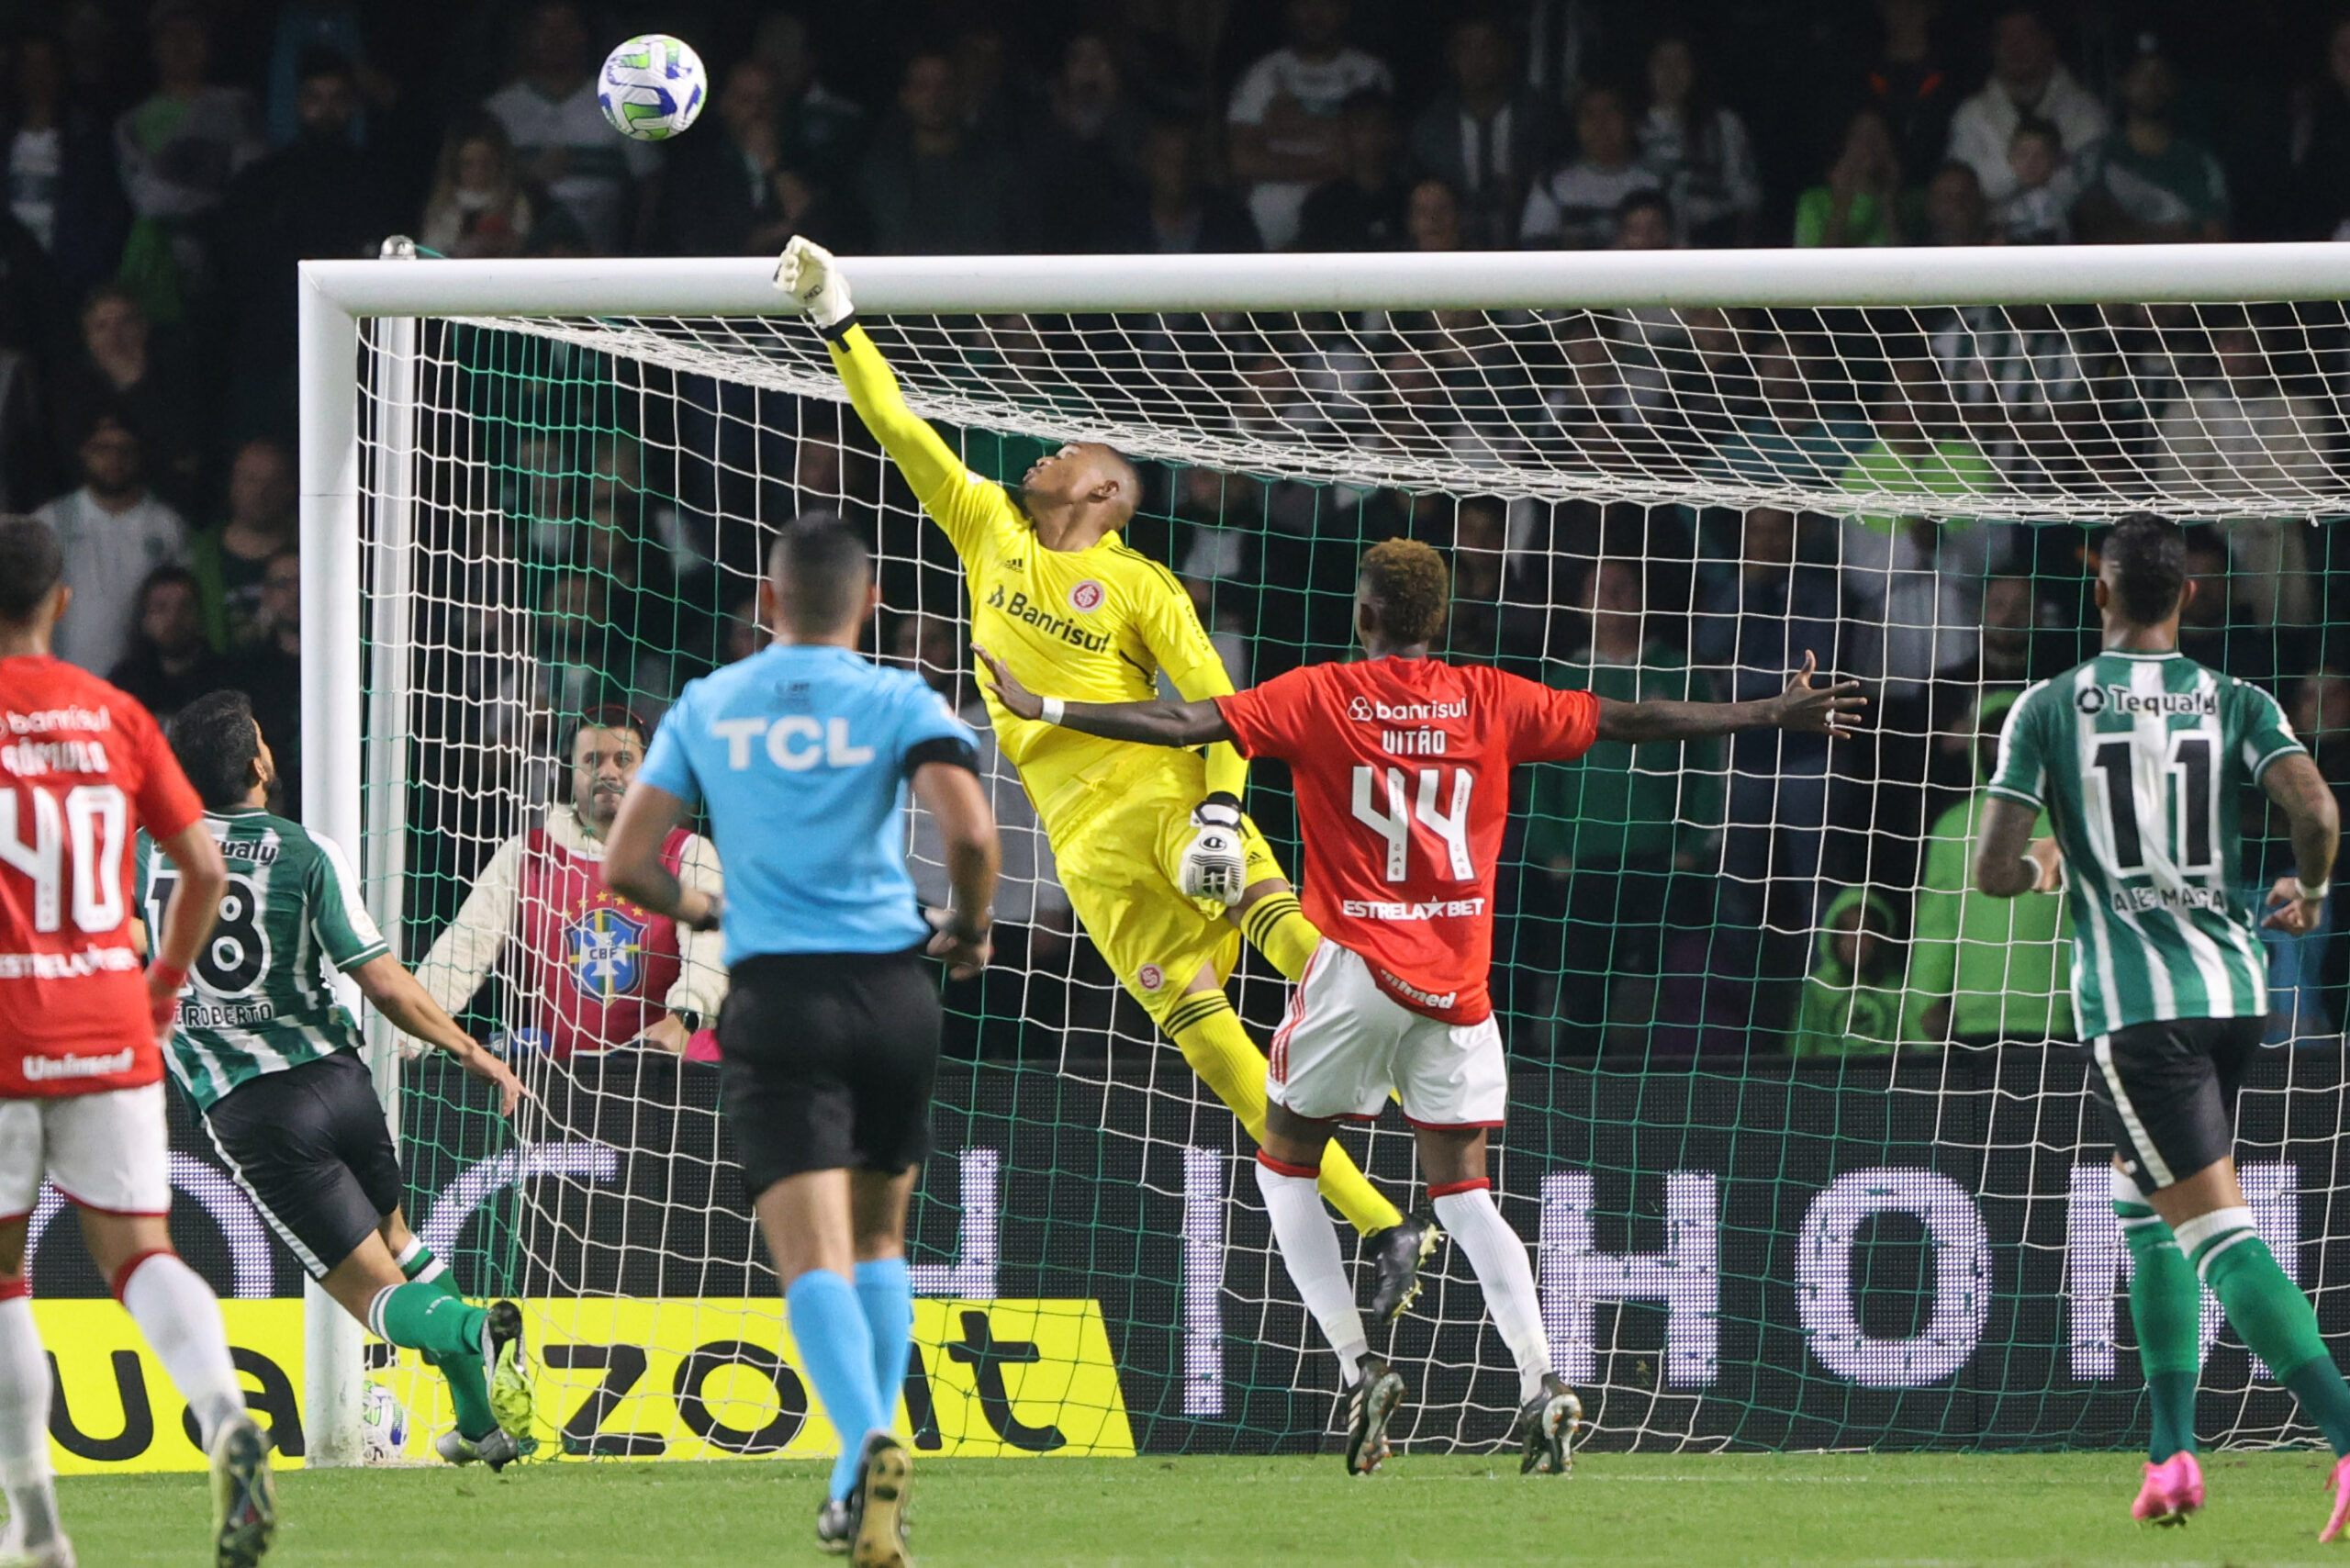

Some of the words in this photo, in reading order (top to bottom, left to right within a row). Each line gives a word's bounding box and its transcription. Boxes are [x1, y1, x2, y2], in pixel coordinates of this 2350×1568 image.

[1006, 590, 1112, 654] Banrisul
[1375, 697, 1469, 721] banrisul
[712, 714, 876, 771] TCL
[1351, 765, 1476, 882] 44
[2086, 733, 2218, 875] 11
[0, 785, 127, 934] 40
[217, 839, 277, 866] ualy
[589, 947, 618, 960] CBF
[186, 1002, 274, 1027] ROBERTO
[23, 1047, 135, 1081] Unimed
